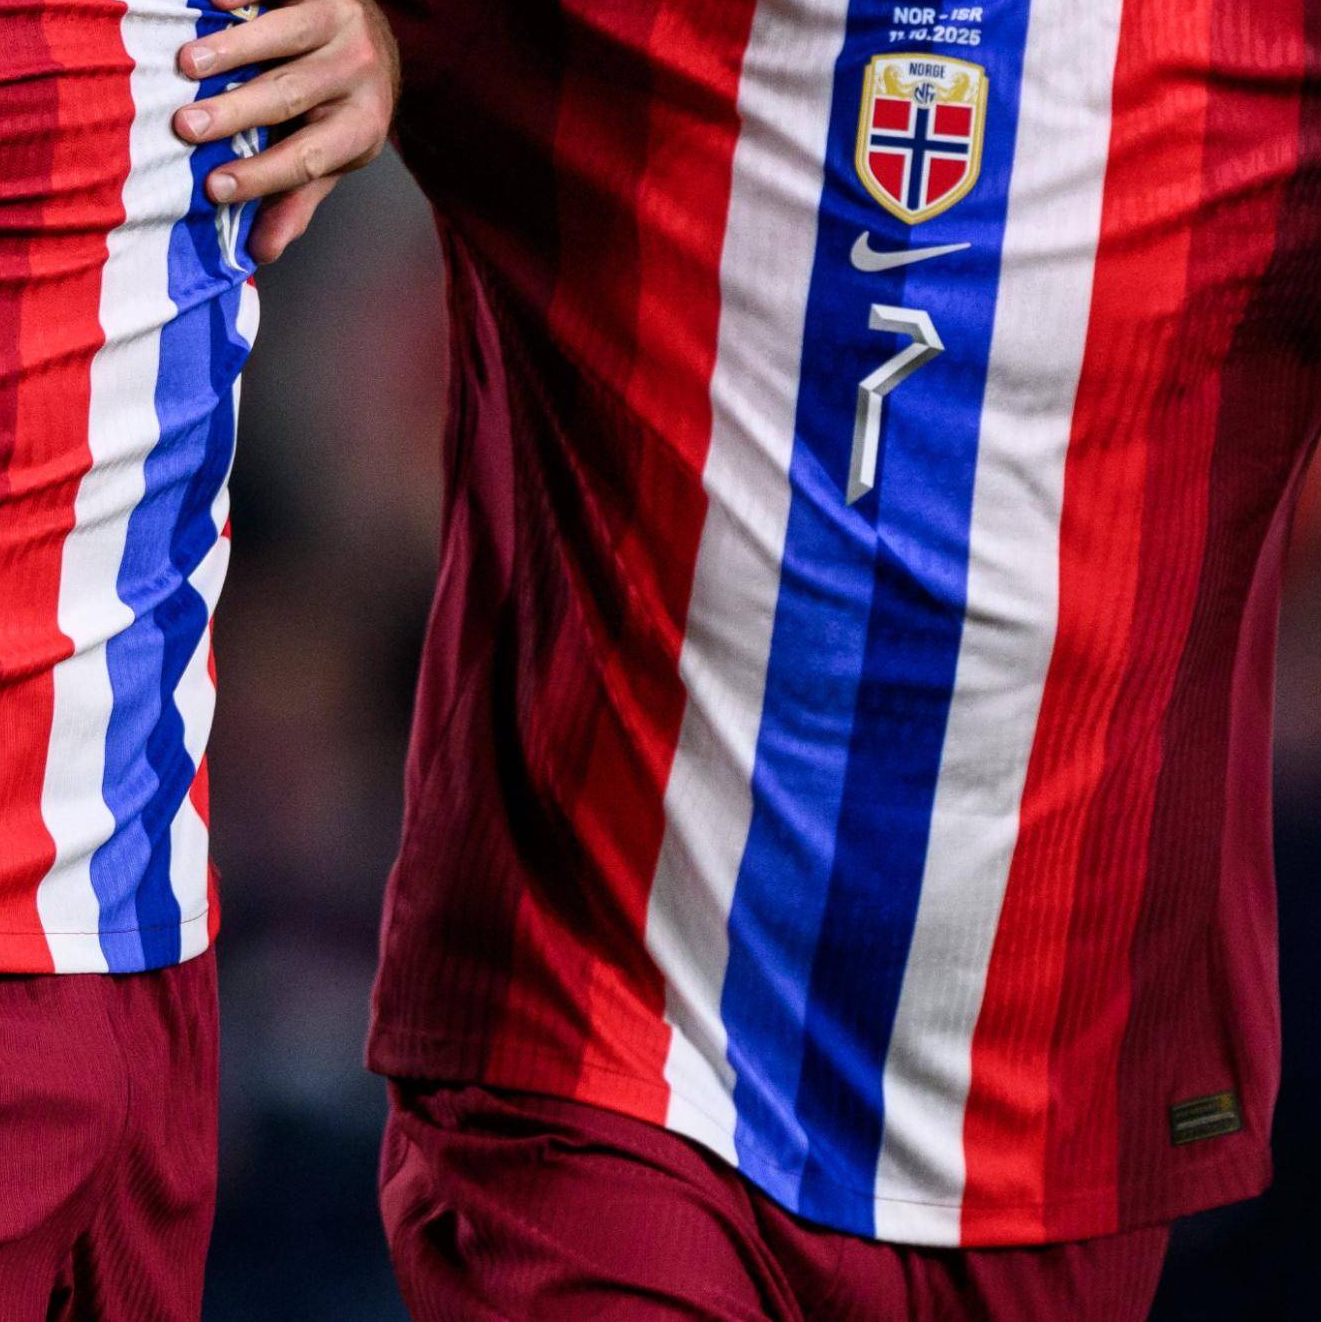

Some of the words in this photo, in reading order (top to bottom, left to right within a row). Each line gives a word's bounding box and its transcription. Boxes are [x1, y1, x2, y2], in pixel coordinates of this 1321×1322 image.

[893, 6, 936, 25] NOR
[950, 6, 984, 22] ISR
[908, 62, 947, 79] NORGE
[845, 303, 945, 507] 7
